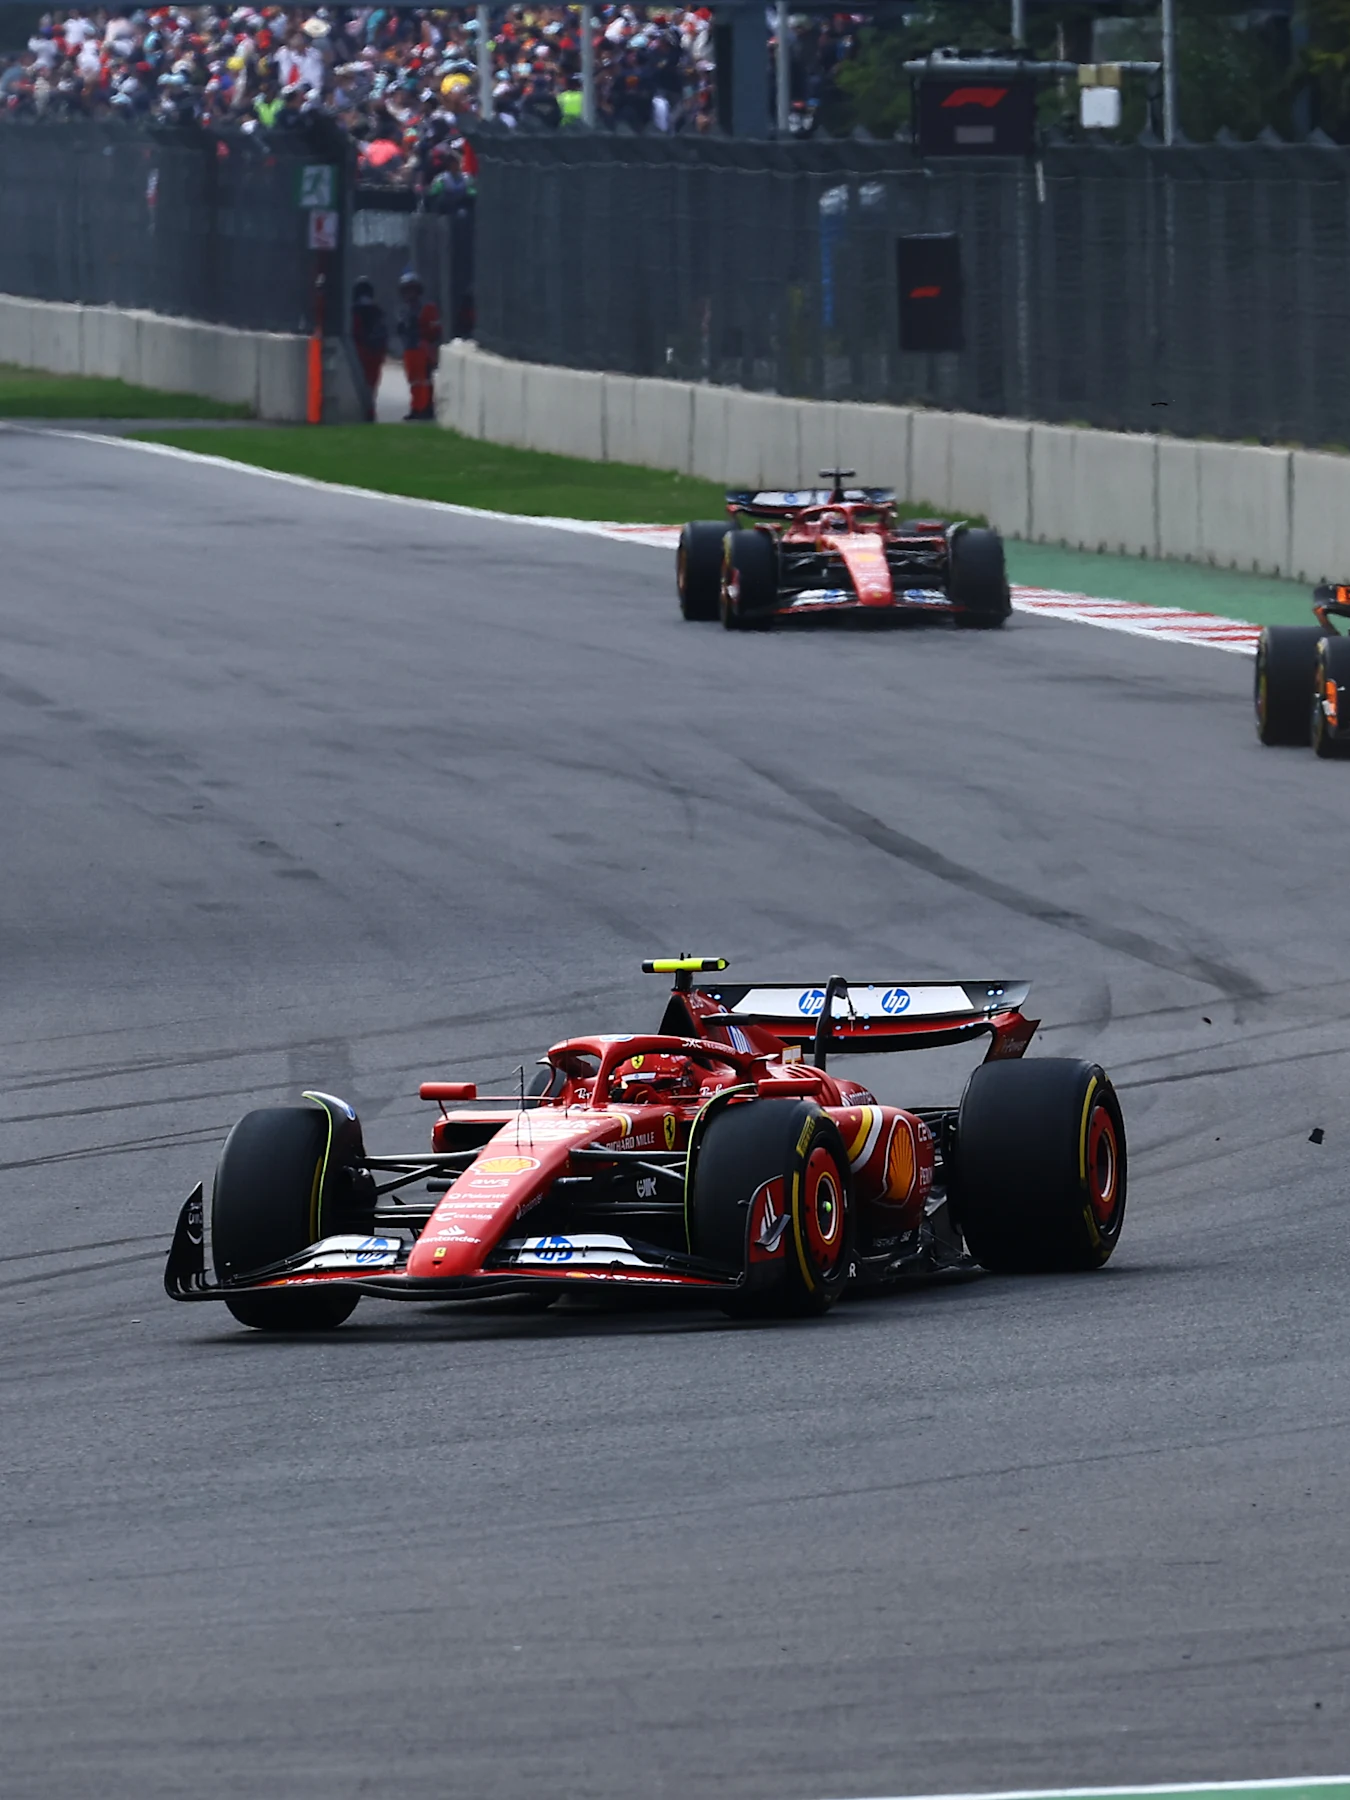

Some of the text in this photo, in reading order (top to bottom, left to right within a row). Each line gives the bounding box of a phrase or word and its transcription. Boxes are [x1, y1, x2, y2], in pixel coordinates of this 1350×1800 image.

[800, 989, 826, 1015] hp
[883, 988, 910, 1014] hp
[635, 1131, 655, 1147] MILLE
[453, 1212, 493, 1220] CELSIUS
[416, 1235, 481, 1244] Santander
[536, 1236, 573, 1261] hp
